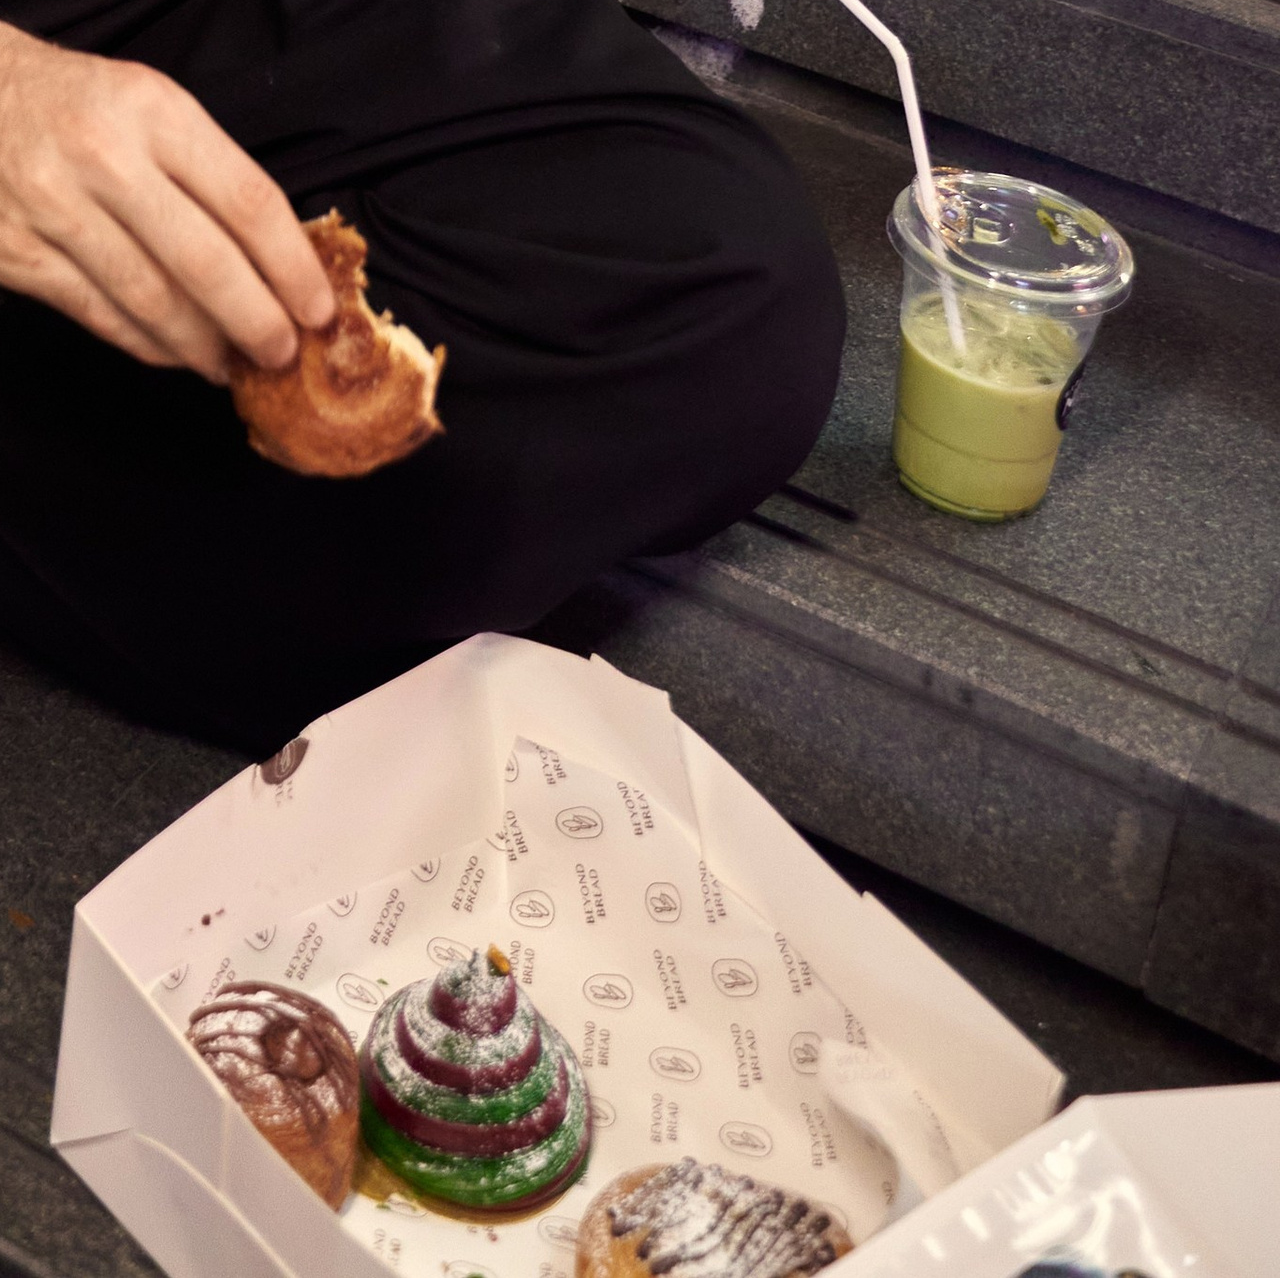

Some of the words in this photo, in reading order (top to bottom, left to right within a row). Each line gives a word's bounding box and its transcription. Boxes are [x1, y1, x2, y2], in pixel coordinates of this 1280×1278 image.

[506, 810, 529, 854] BREAD
[616, 781, 643, 836] BEYOND
[451, 855, 479, 911] BEYOND
[463, 868, 485, 913] BREAD
[575, 863, 595, 924] BEYOND
[588, 868, 606, 918] BREAD
[698, 860, 716, 924] BEYOND
[709, 873, 727, 917] BREA
[369, 888, 400, 945] BEYOND
[381, 901, 406, 947] BREAD
[285, 922, 318, 979] BEYOND
[297, 935, 323, 981] BREAD
[522, 948, 535, 985] BREAD
[774, 931, 801, 994] BEYOND
[653, 949, 677, 1010] BEYOND
[666, 955, 687, 1004] BREAD
[583, 1021, 596, 1068] BEYOND
[598, 1029, 610, 1066] BREAD
[730, 1023, 750, 1089] BEYOND
[745, 1029, 763, 1081] BREAD
[651, 1093, 663, 1143] BEYOND
[667, 1102, 679, 1141] BREAD
[799, 1102, 823, 1167] BEYOND
[813, 1108, 838, 1161] BREAD
